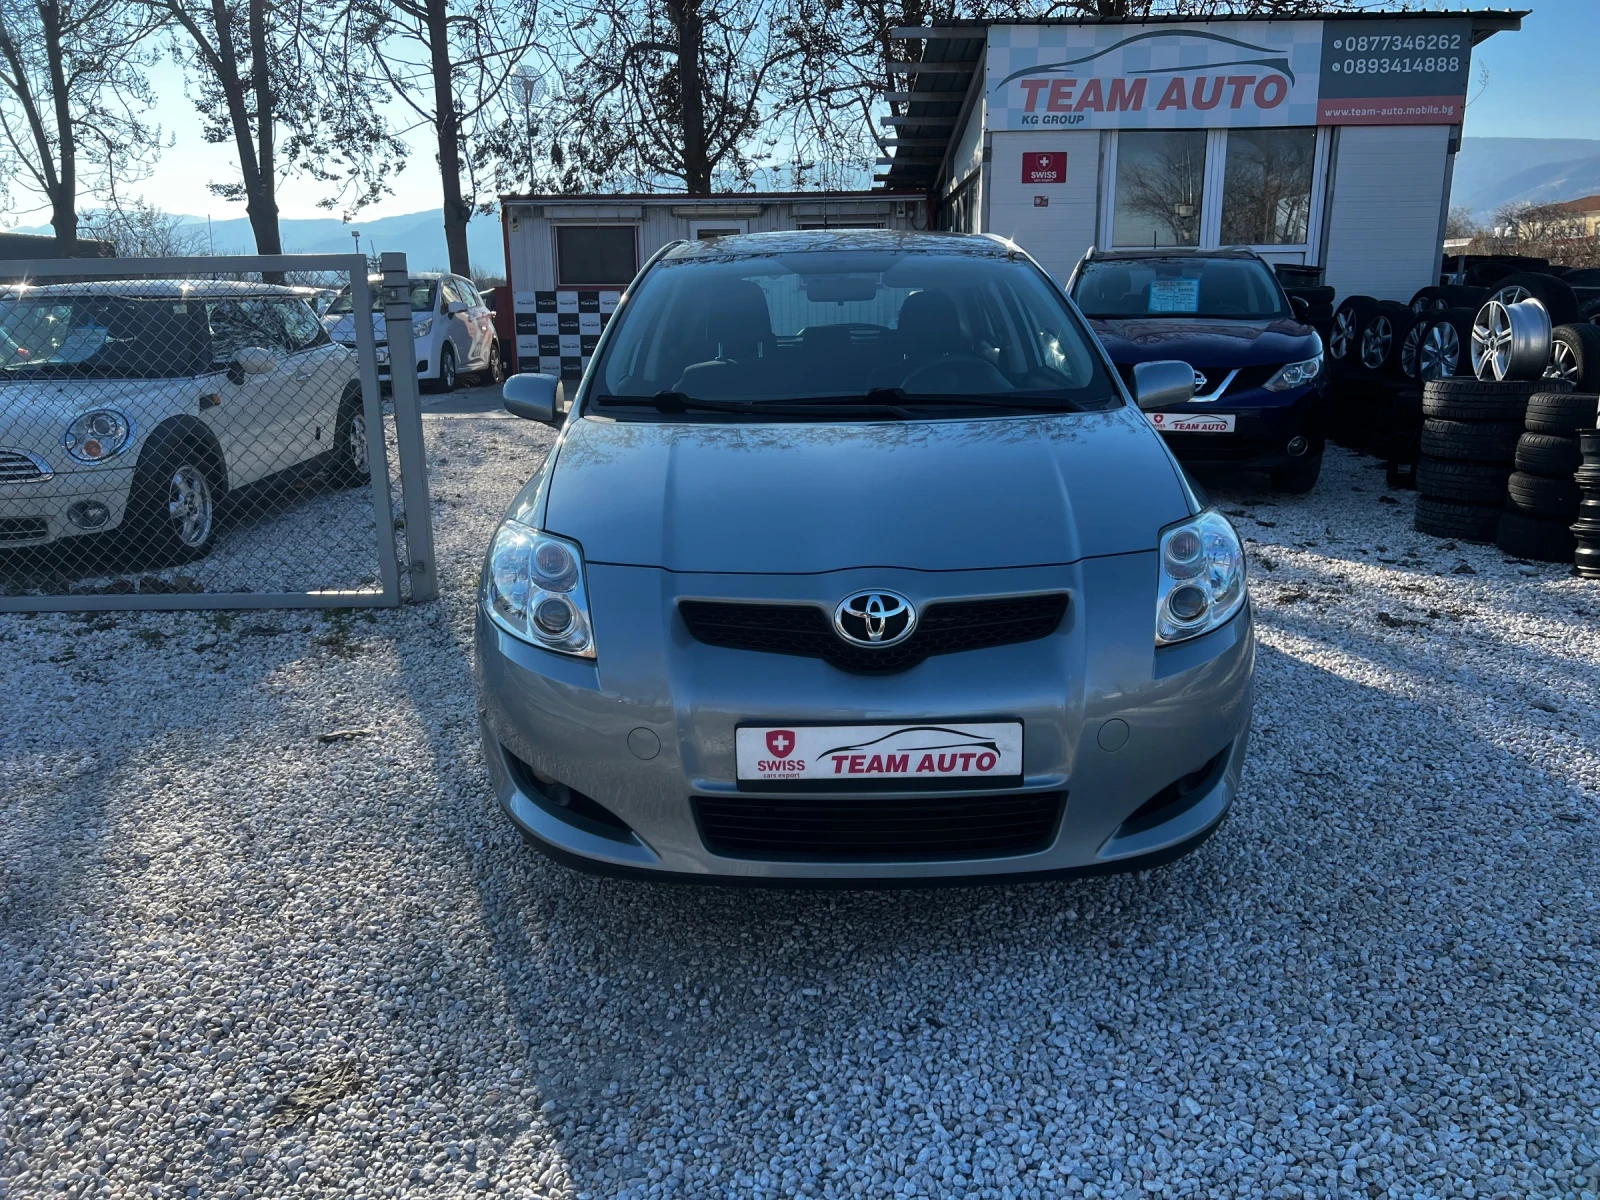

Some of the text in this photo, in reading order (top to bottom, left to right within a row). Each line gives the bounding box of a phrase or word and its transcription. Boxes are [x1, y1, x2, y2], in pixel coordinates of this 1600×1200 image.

[1345, 34, 1461, 52] 0877346262
[1343, 57, 1459, 74] 0893414888
[1020, 75, 1288, 112] TEAM AUTO
[1324, 105, 1454, 117] www.team-auto.mobile.bg
[1021, 115, 1085, 125] KG GROUP
[1031, 171, 1057, 179] SWISS
[1201, 423, 1227, 431] AUTO
[757, 759, 806, 772] SWISS
[831, 752, 997, 774] TEAM AUTO
[777, 772, 801, 780] export
